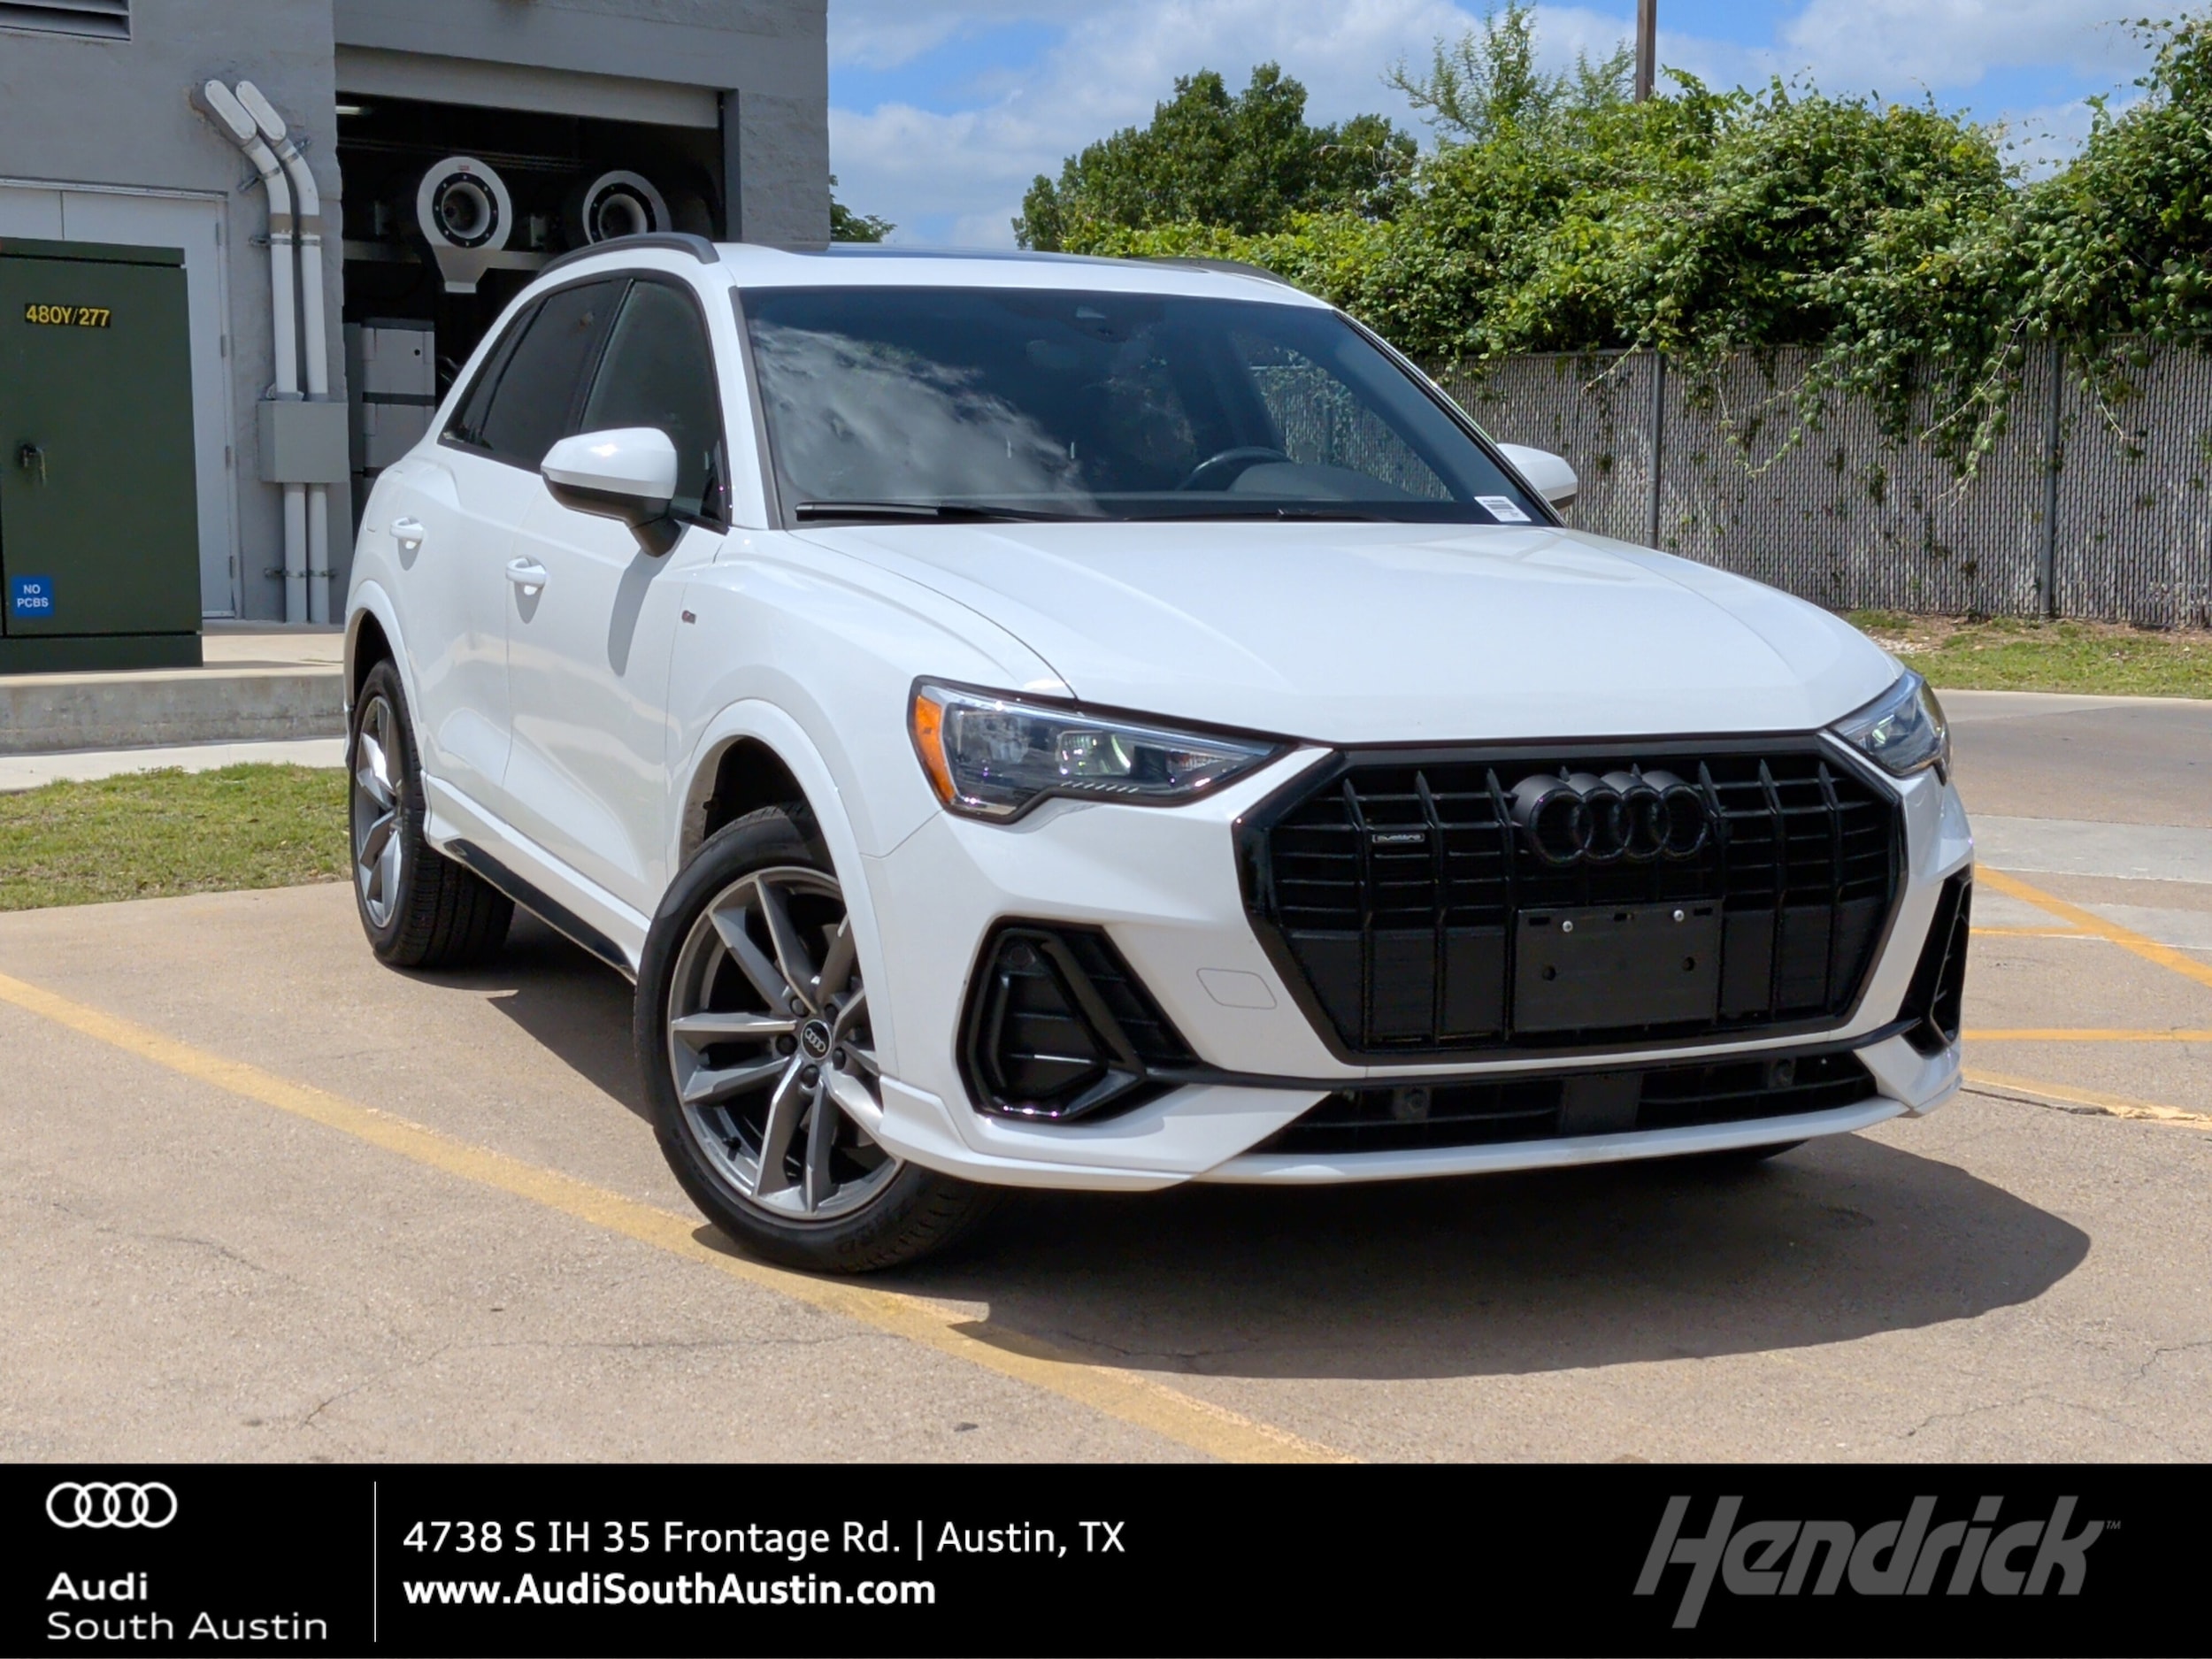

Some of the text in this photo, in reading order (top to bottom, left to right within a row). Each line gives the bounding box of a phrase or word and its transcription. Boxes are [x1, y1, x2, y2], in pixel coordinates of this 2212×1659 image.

[27, 304, 110, 326] 480Y/277
[23, 584, 41, 594] NO
[17, 597, 49, 608] PCBS
